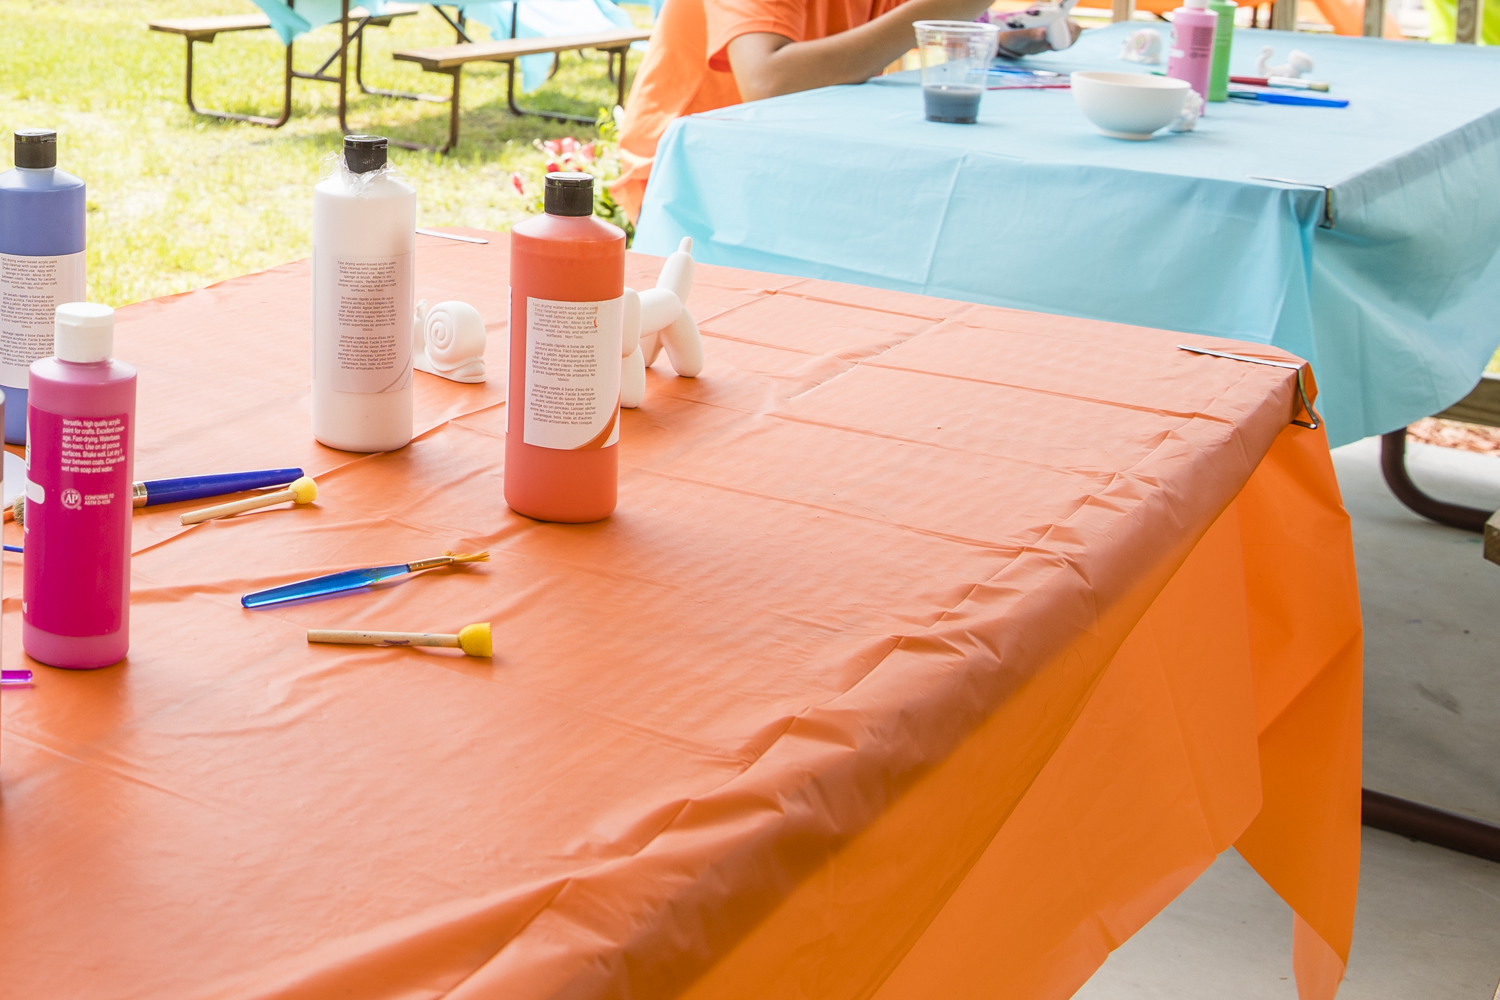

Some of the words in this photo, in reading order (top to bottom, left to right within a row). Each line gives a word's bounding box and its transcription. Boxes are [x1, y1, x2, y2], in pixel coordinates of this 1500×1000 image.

[62, 419, 83, 427] Versatile,
[83, 420, 93, 428] high
[108, 418, 121, 426] acrylic
[115, 425, 125, 433] cover-
[72, 435, 99, 443] Fast-drying.
[62, 441, 84, 450] Non-toxic.
[107, 441, 120, 450] porous
[83, 450, 96, 458] Shake
[65, 494, 79, 504] AP
